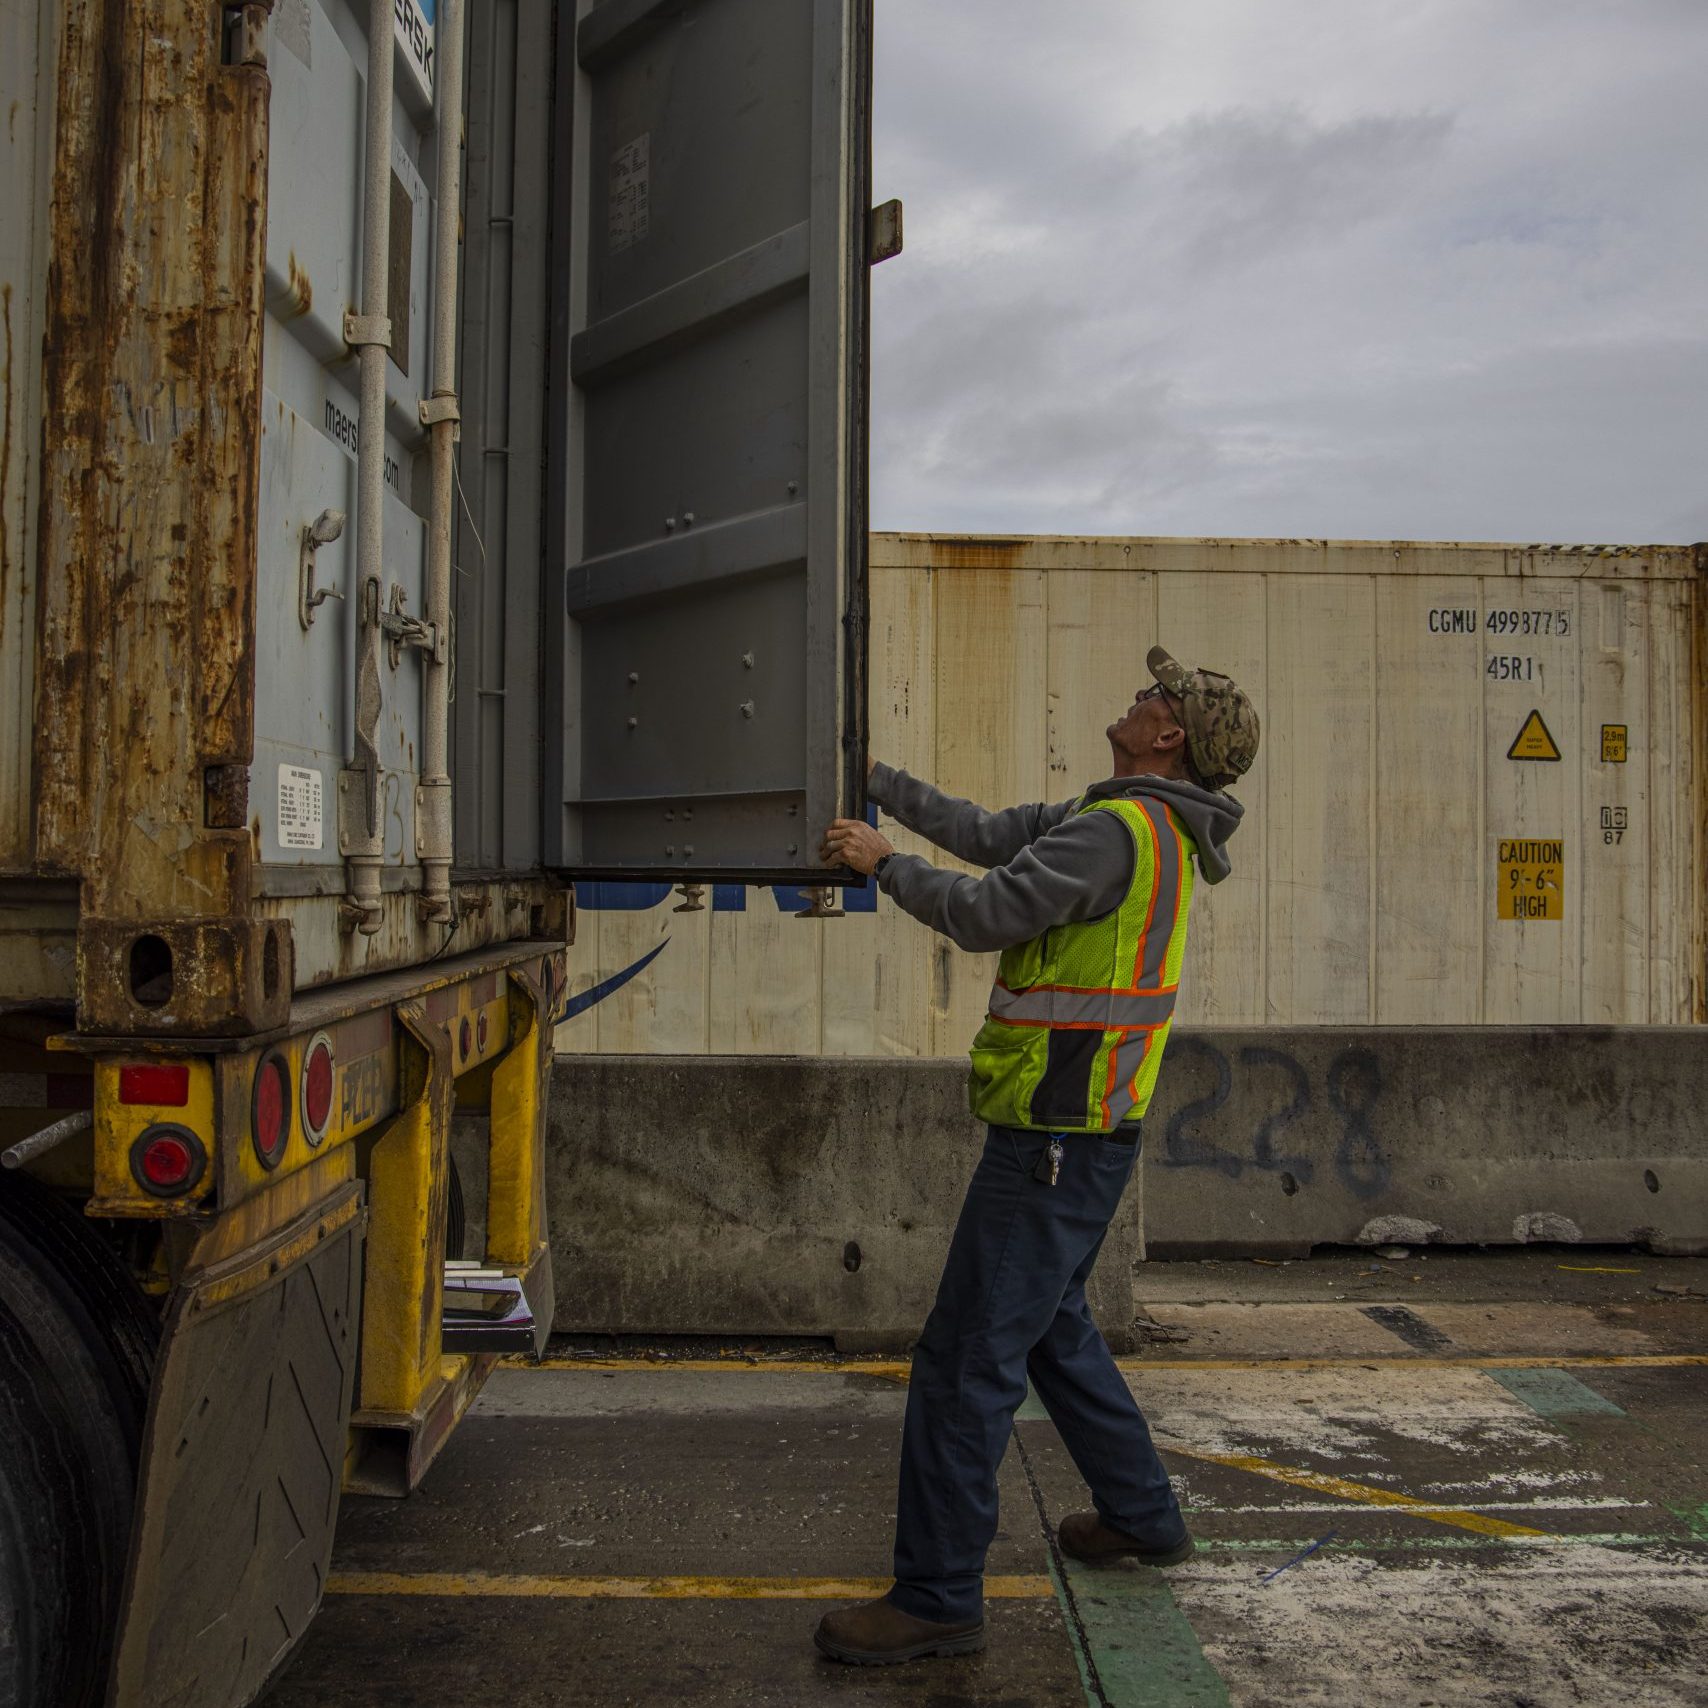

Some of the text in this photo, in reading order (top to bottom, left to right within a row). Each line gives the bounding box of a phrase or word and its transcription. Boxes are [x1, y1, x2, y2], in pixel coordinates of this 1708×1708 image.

[1429, 609, 1476, 633] CGMU
[1487, 656, 1532, 680] 45R1
[1604, 831, 1623, 845] 87
[1500, 842, 1562, 864] CAUTION
[1513, 896, 1547, 917] HIGH
